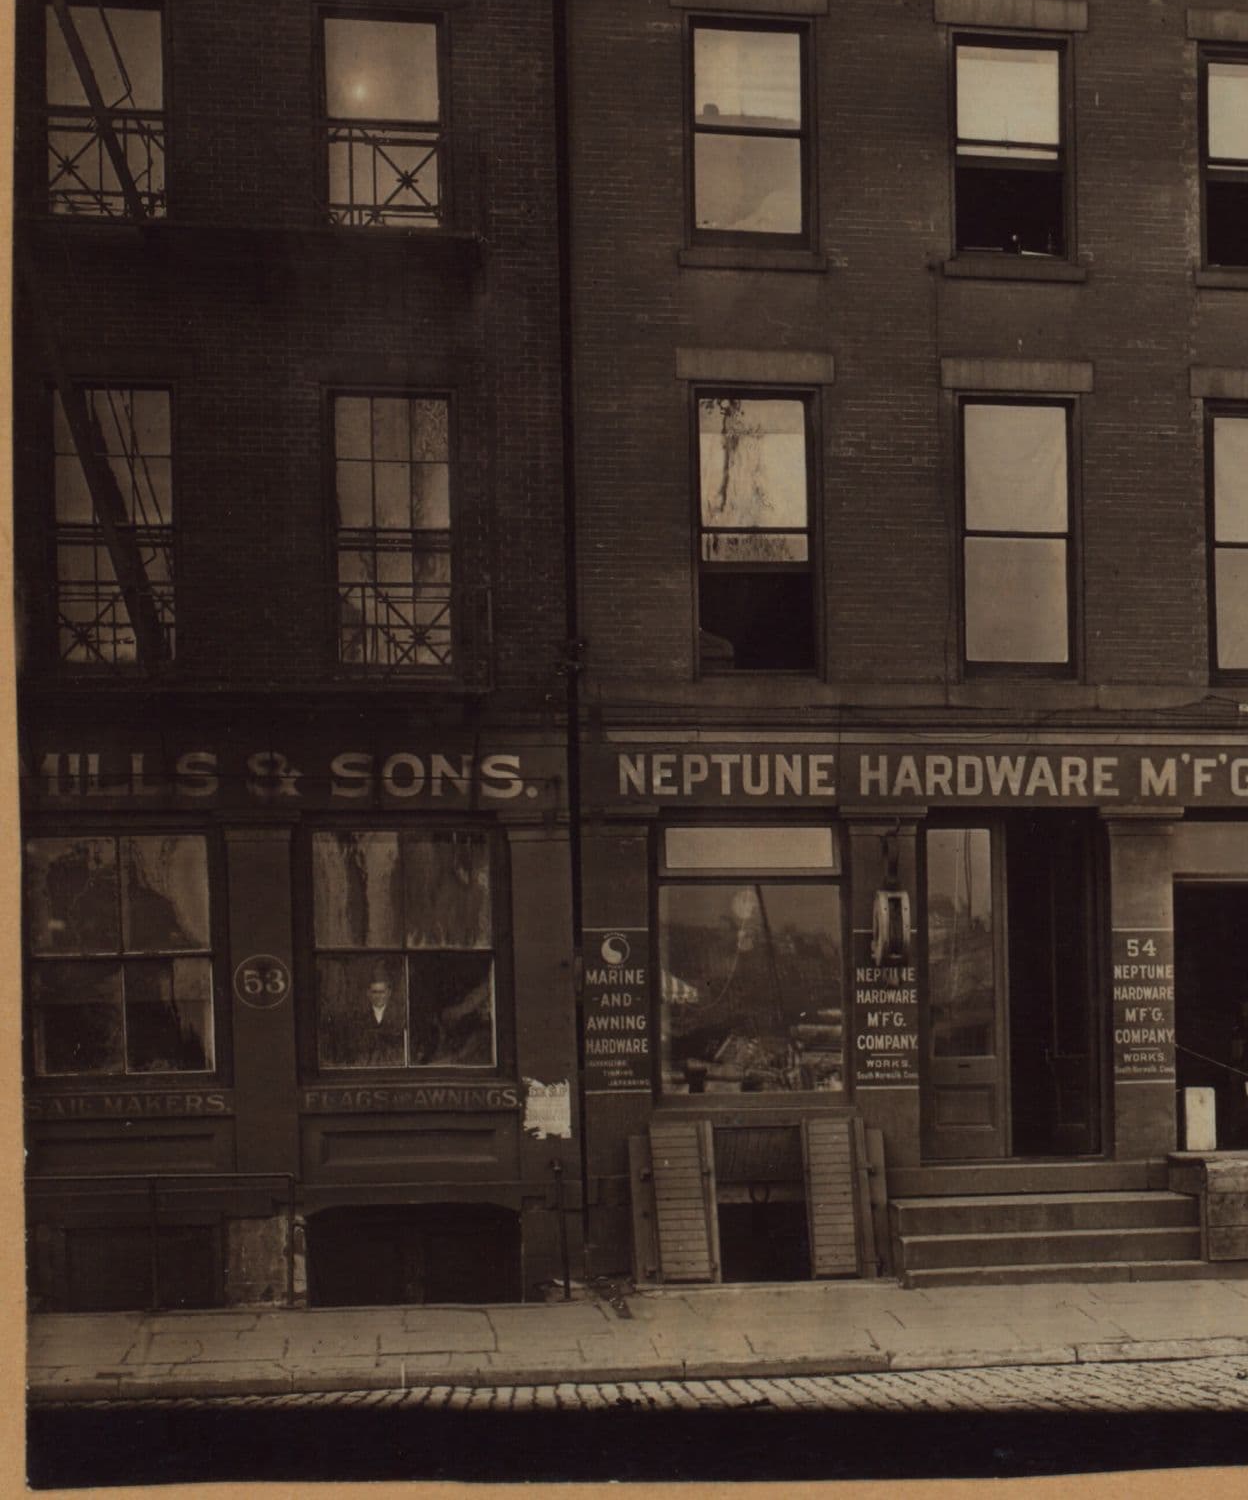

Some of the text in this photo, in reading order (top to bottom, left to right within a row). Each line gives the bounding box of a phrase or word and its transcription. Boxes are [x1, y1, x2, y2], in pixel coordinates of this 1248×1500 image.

[330, 751, 539, 799] SONS.
[617, 753, 837, 797] NEPTUNE
[859, 755, 1121, 797] HARDWARE
[1127, 938, 1157, 957] 54
[585, 968, 645, 985] MARINE
[1113, 964, 1174, 980] NEPTUNE
[243, 969, 286, 994] 53
[600, 992, 632, 1008] AND
[856, 988, 918, 1005] HARDWARE
[1113, 985, 1175, 1001] HARDWARE
[586, 1014, 647, 1031] AWNING
[585, 1037, 649, 1054] HARDWARE
[304, 1090, 391, 1110] FLAGS
